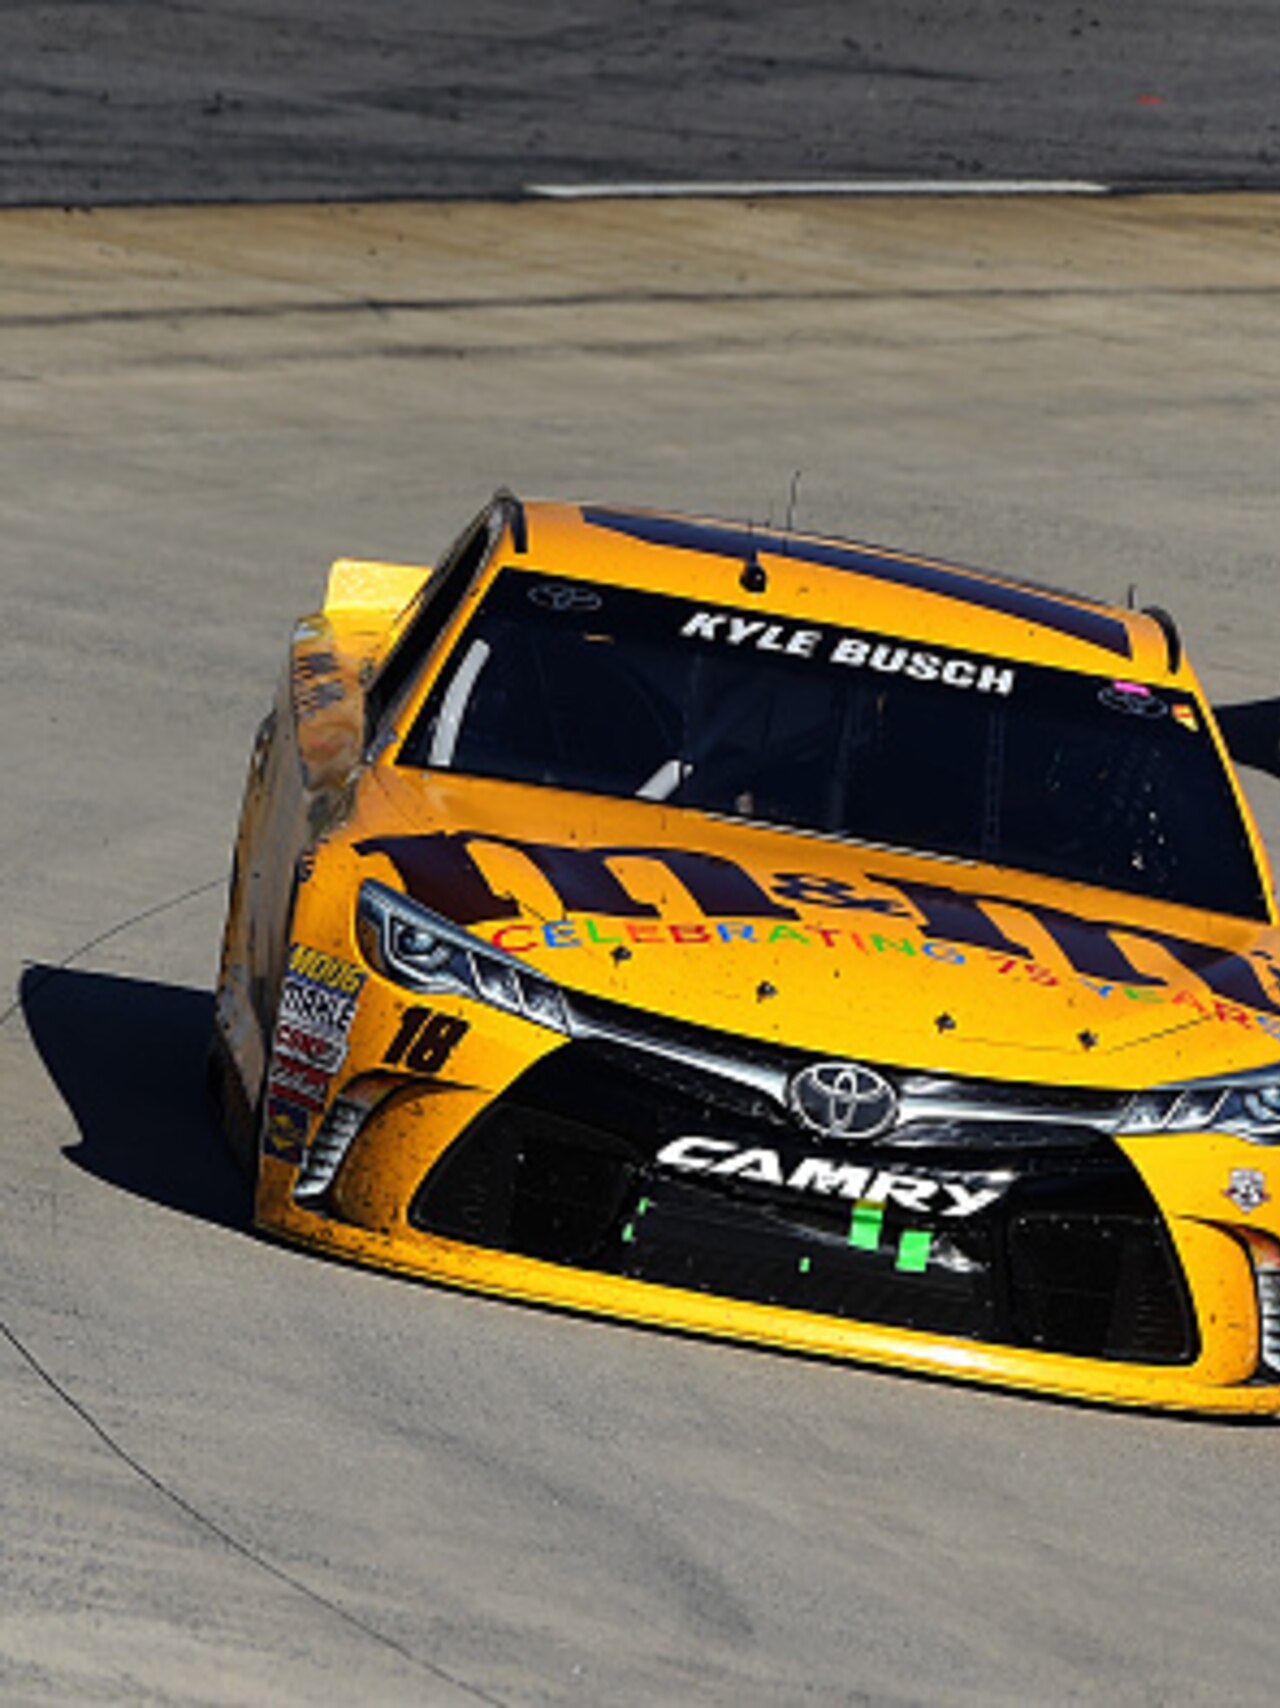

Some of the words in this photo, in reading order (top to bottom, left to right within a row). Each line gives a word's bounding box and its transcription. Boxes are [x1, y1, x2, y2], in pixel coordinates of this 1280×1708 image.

[681, 611, 820, 658] KYLE
[831, 636, 1016, 695] BUSCH
[491, 919, 966, 965] CELEBRATING
[383, 1006, 470, 1074] 18
[656, 1135, 1018, 1217] CAMRY
